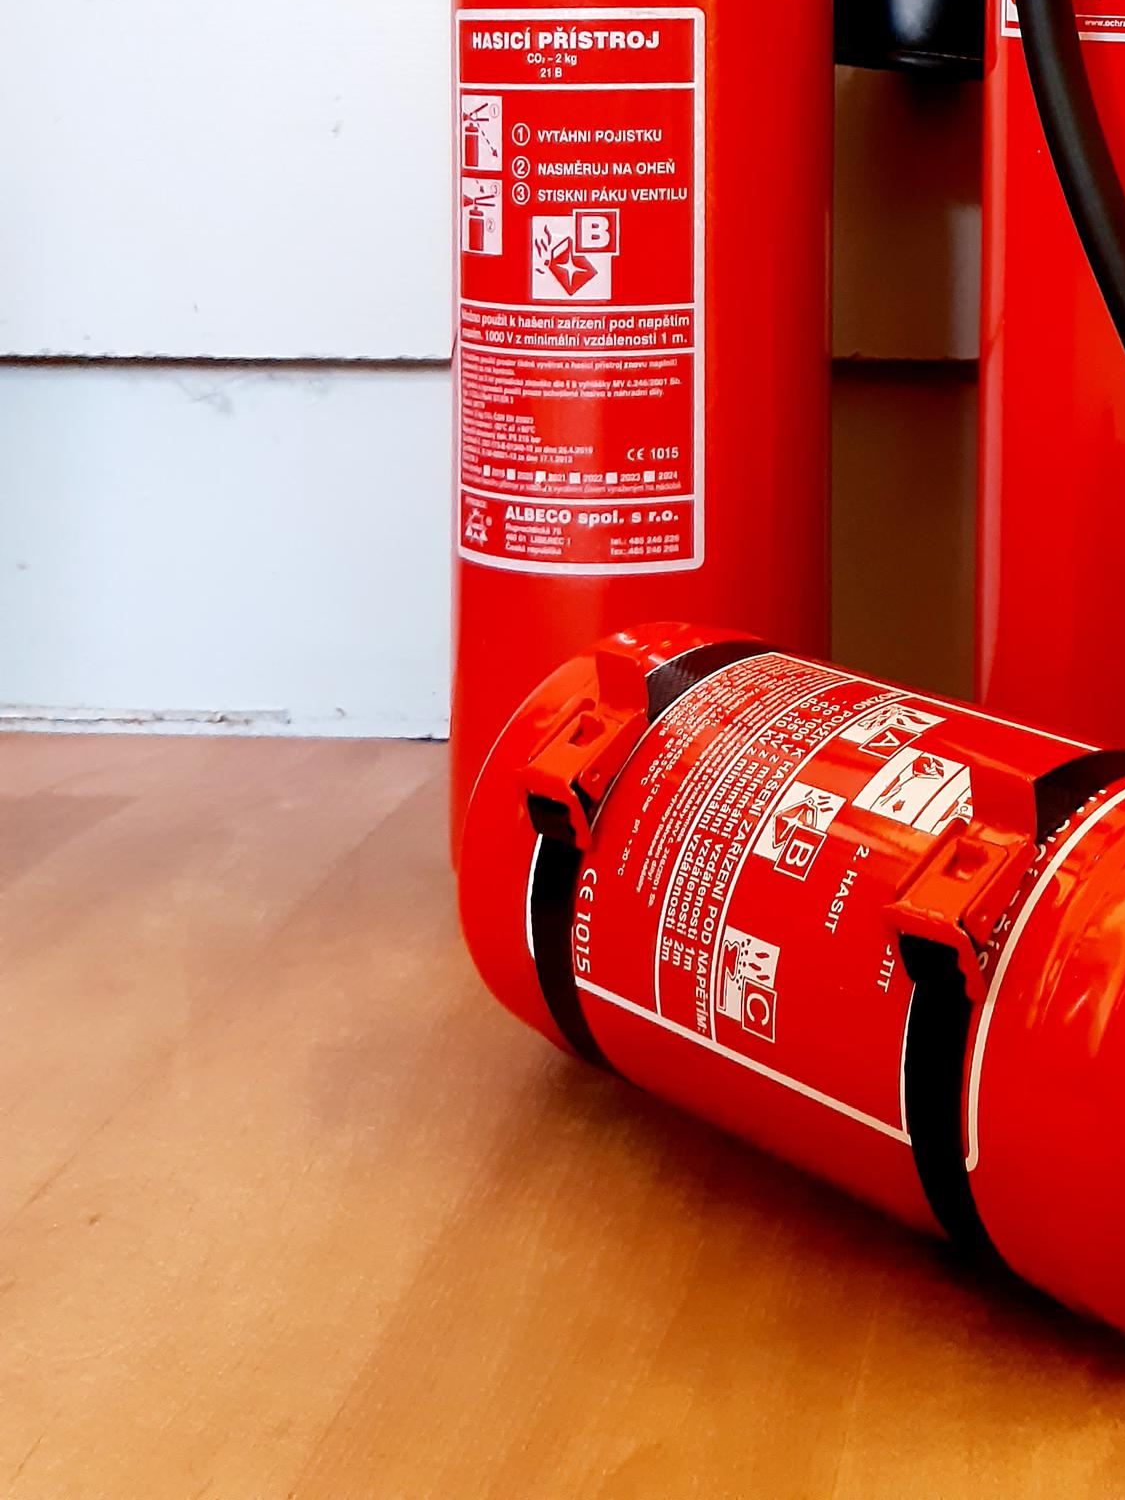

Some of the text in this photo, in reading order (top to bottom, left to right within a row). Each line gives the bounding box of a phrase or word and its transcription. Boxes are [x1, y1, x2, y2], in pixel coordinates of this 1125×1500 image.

[472, 27, 660, 50] HASICÍ PŘÍSTROJ
[564, 53, 578, 66] kg
[540, 68, 563, 78] 21 B
[537, 127, 663, 143] VYTÁHNI POJISTKU
[537, 158, 676, 176] NASMĚRUJ NA OHEŇ
[537, 186, 688, 202] STISKNI PÁKU VENTILU
[580, 215, 611, 250] B
[518, 314, 690, 332] hašení zařízení pod napětím
[484, 330, 657, 347] 1000 minimální vzdálenosti
[650, 446, 679, 460] 1015
[504, 506, 679, 528] ALBECO spol. r.o.
[687, 717, 823, 941] 1000 minimální vzdálenosti
[676, 761, 760, 935] minimální vzdálenosti
[785, 839, 814, 867] B
[695, 760, 794, 1034] HAŠENÍ ZAŘÍZENÍ POD NAPĚTÍM:
[825, 870, 857, 933] HASIT
[575, 911, 592, 974] 1015
[747, 993, 769, 1025] C
